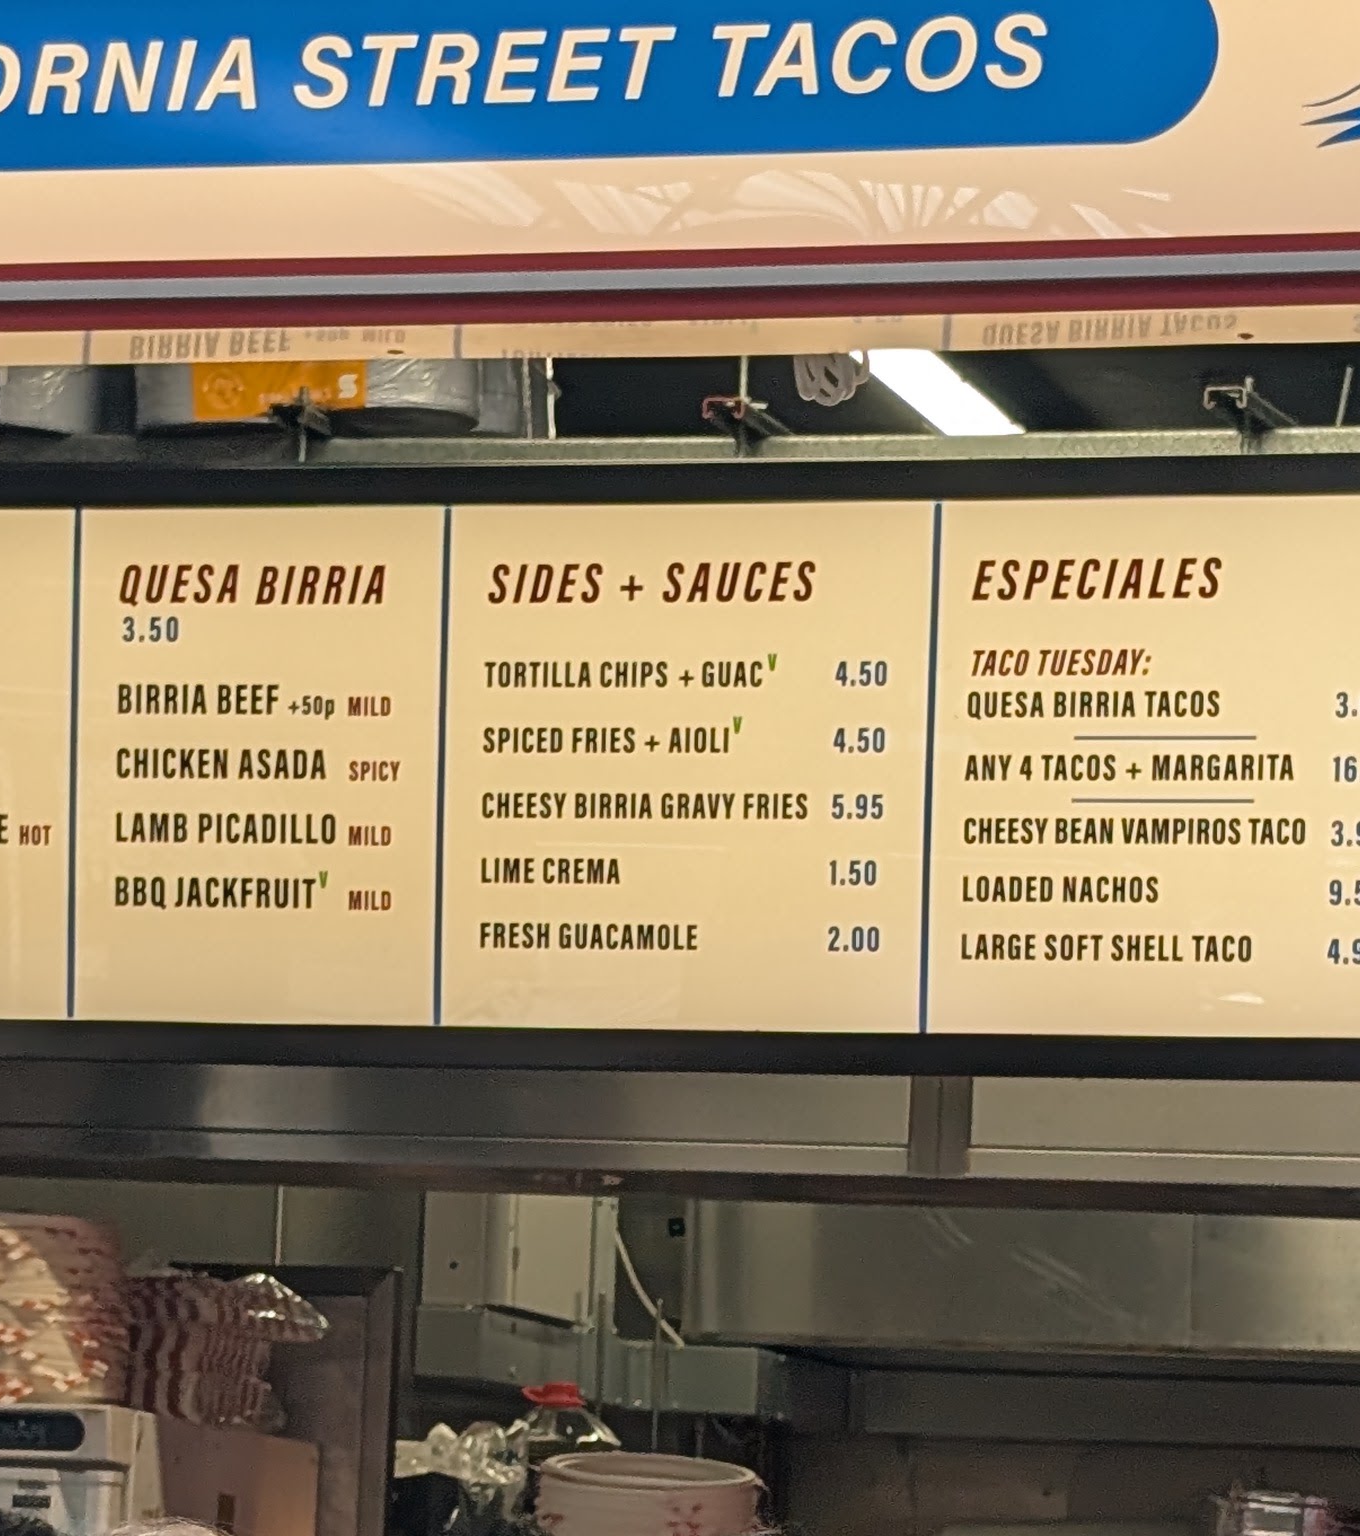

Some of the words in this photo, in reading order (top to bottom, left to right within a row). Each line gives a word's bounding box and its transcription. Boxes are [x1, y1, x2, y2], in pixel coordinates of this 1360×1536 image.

[292, 26, 677, 109] STREET
[712, 14, 1049, 98] TACOS
[119, 563, 239, 607] QUESA
[255, 564, 386, 605] BIRRIA
[487, 562, 603, 604] SIDES
[662, 560, 816, 603] SAUCES
[971, 557, 1222, 601] ESPECIALES
[122, 615, 179, 643] 3.50
[484, 661, 591, 688] TORTILLA
[599, 660, 668, 688] CHIPS
[835, 660, 888, 687] 4.50
[971, 649, 1030, 677] TACO
[1037, 648, 1152, 677] TUESDAY:
[117, 683, 207, 715] BIRRIA
[217, 684, 279, 715] BEEF
[347, 696, 391, 717] MILD
[967, 691, 1044, 720] QUESA
[1053, 690, 1136, 718] BIRRIA
[1144, 690, 1220, 718] TACOS
[482, 726, 563, 754] SPICED
[571, 726, 636, 754] FRIES
[833, 727, 886, 754] 4.50
[116, 747, 228, 779] CHICKEN
[238, 748, 326, 780] ASADA
[348, 760, 401, 782] SPICY
[964, 754, 1012, 782] ANY
[1019, 755, 1033, 781] 4
[1040, 754, 1116, 782] TACOS
[1151, 753, 1294, 781] MARGARITA
[481, 792, 567, 819] CHEESY
[574, 792, 653, 820] BIRRIA
[660, 792, 736, 820] GRAVY
[743, 792, 808, 820] FRIES
[831, 793, 884, 820] 5.95
[19, 824, 52, 846] HOT
[116, 812, 188, 843] LAMB
[198, 812, 336, 845] PICADILLO
[348, 825, 392, 847] MILD
[963, 817, 1049, 845] CHEESY
[1054, 817, 1114, 845] BEAN
[1121, 817, 1241, 845] VAMPIROS
[1248, 817, 1306, 845] TACO
[481, 857, 535, 884] LIME
[542, 857, 620, 885] CREMA
[829, 859, 877, 887] 1.50
[115, 876, 167, 910] BBQ
[348, 890, 392, 911] MILD
[962, 875, 1053, 903] LOADED
[1062, 875, 1159, 904] NACHOS
[479, 922, 550, 949] FRESH
[558, 922, 698, 951] GUACAMOLE
[827, 925, 880, 953] 2.00
[961, 933, 1036, 961] LARGE
[1044, 934, 1104, 961] SOFT
[1110, 934, 1184, 962] SHELL
[1191, 935, 1252, 963] TACO
